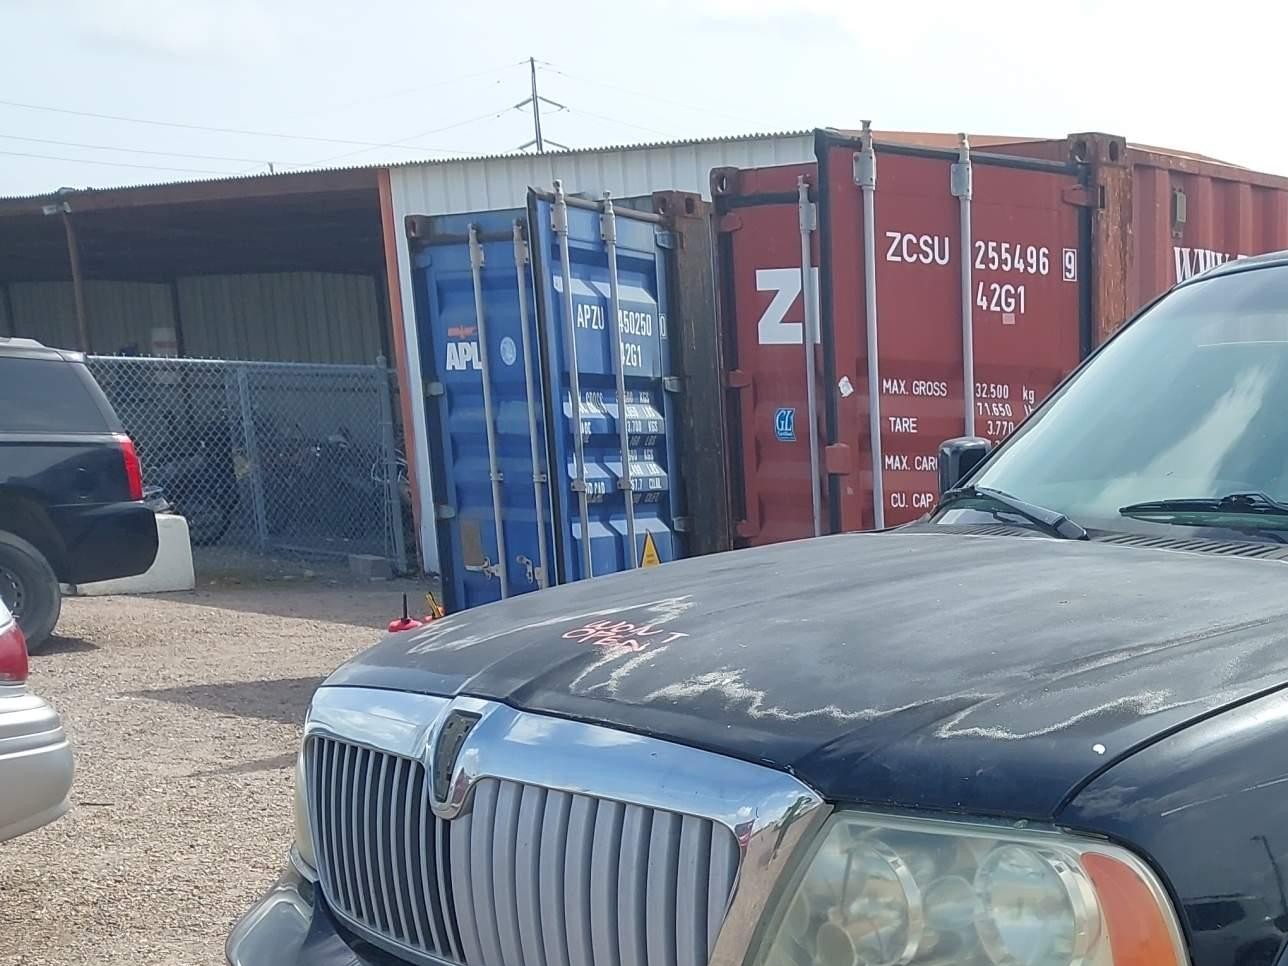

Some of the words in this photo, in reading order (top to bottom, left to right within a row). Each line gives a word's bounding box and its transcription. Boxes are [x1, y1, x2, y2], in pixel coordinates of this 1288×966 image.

[885, 231, 950, 266] ZCSU
[974, 240, 1049, 276] 255496
[1064, 250, 1076, 279] 9
[976, 281, 1025, 314] 42G1
[577, 303, 605, 330] APZU
[446, 341, 484, 371] APL
[882, 378, 909, 395] MAX.
[912, 380, 948, 398] GROSS
[975, 383, 1009, 399] 32.500
[1022, 386, 1035, 404] kg
[976, 402, 1013, 417] 71.650
[888, 417, 918, 433] TARE
[986, 420, 1014, 436] 3.770
[884, 455, 911, 470] MAX.
[914, 456, 938, 471] CAR
[890, 493, 909, 508] CU.
